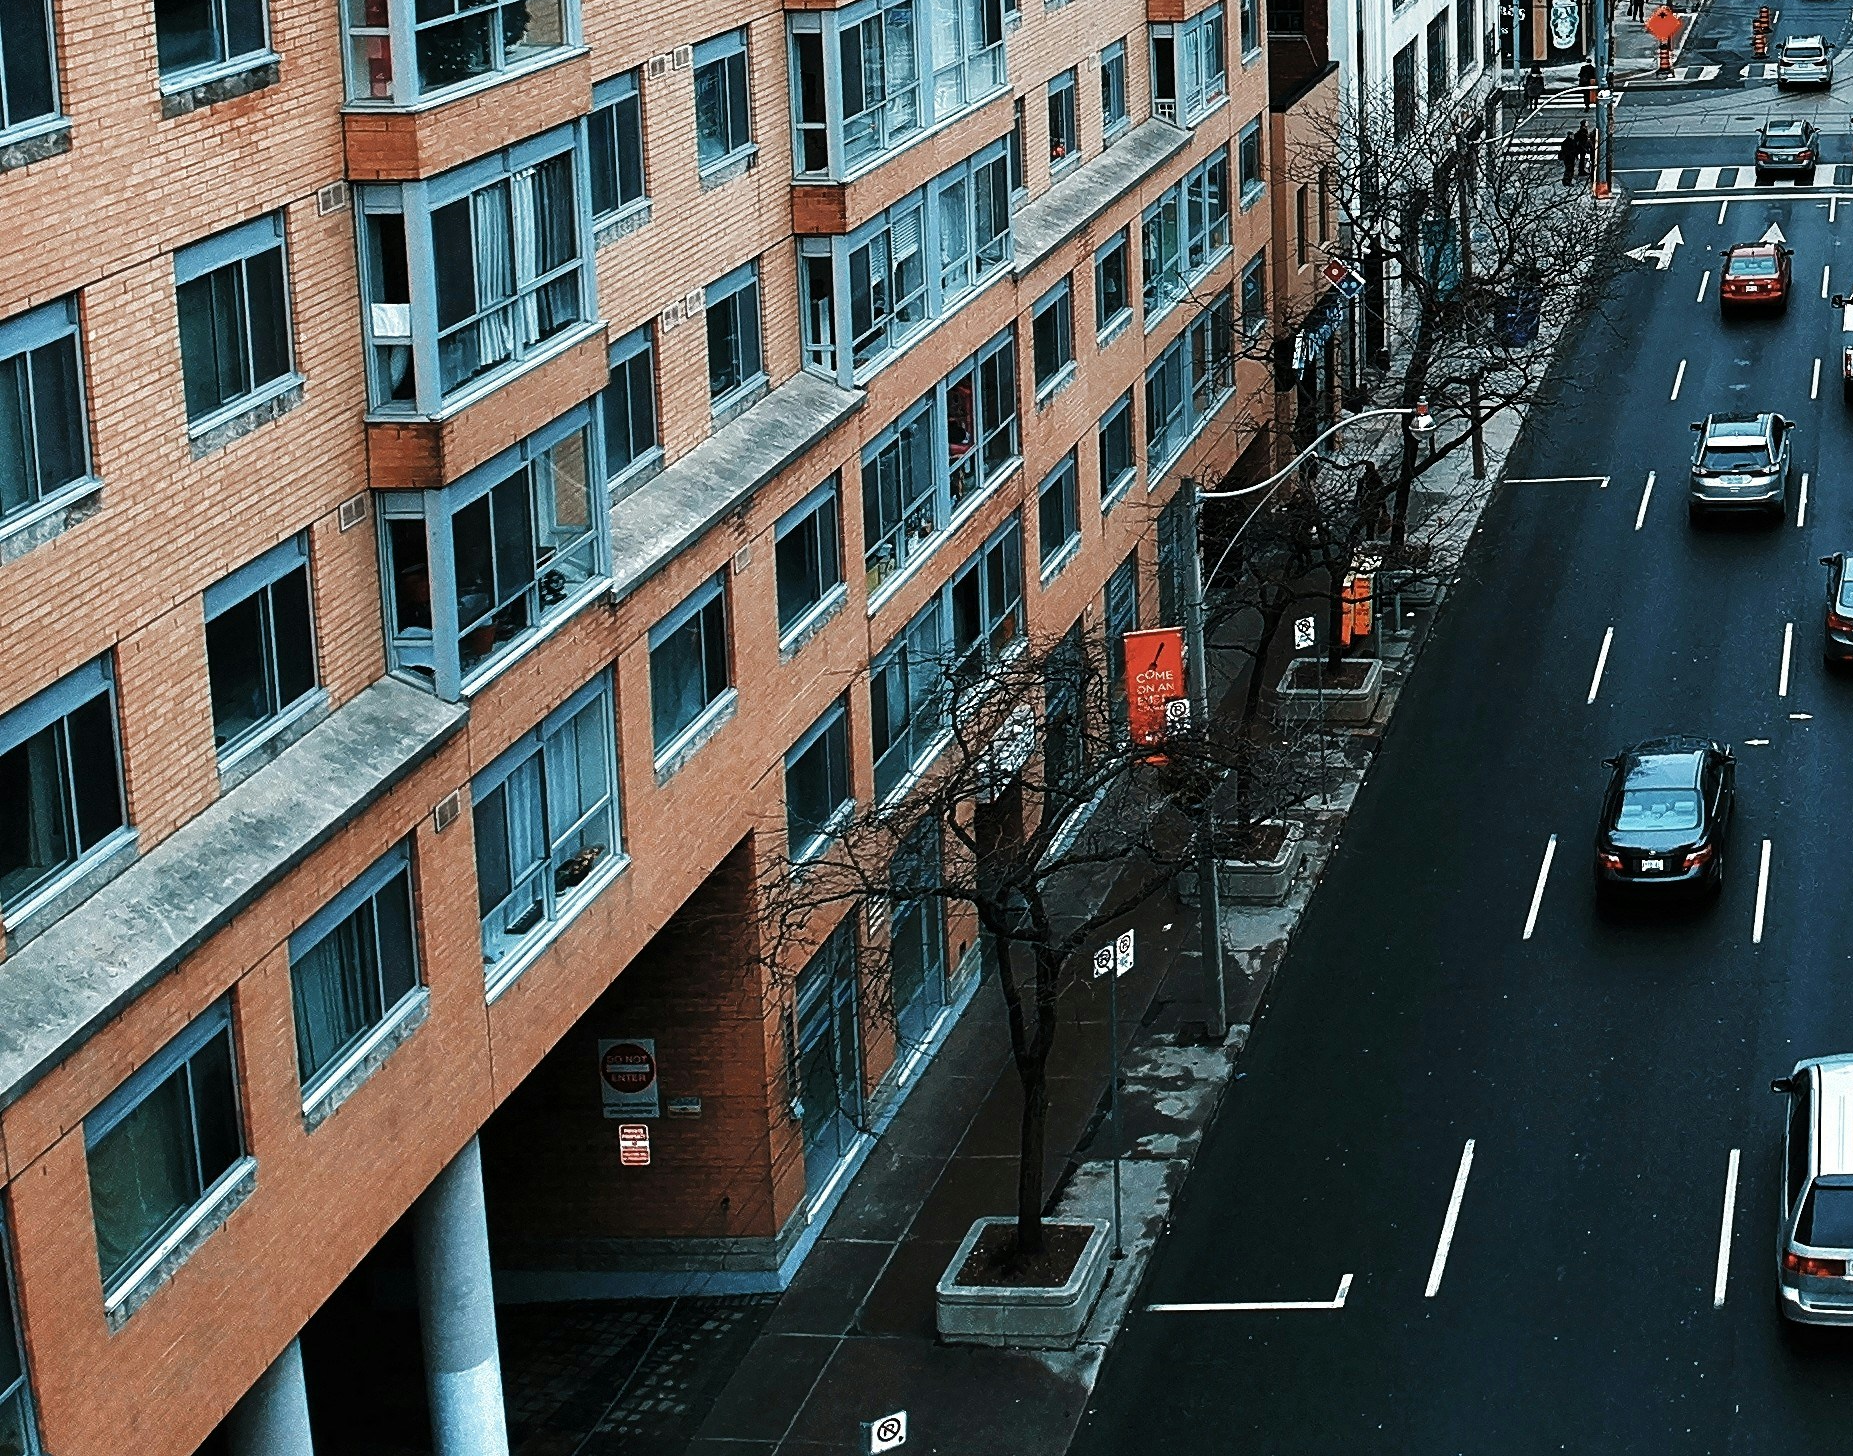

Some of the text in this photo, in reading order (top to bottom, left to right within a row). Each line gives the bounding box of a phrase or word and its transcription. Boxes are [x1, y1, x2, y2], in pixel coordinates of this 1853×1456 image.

[1136, 669, 1174, 684] COME
[1136, 682, 1175, 695] ON AN
[606, 1055, 648, 1064] DO NOT
[611, 1073, 647, 1082] ENTER
